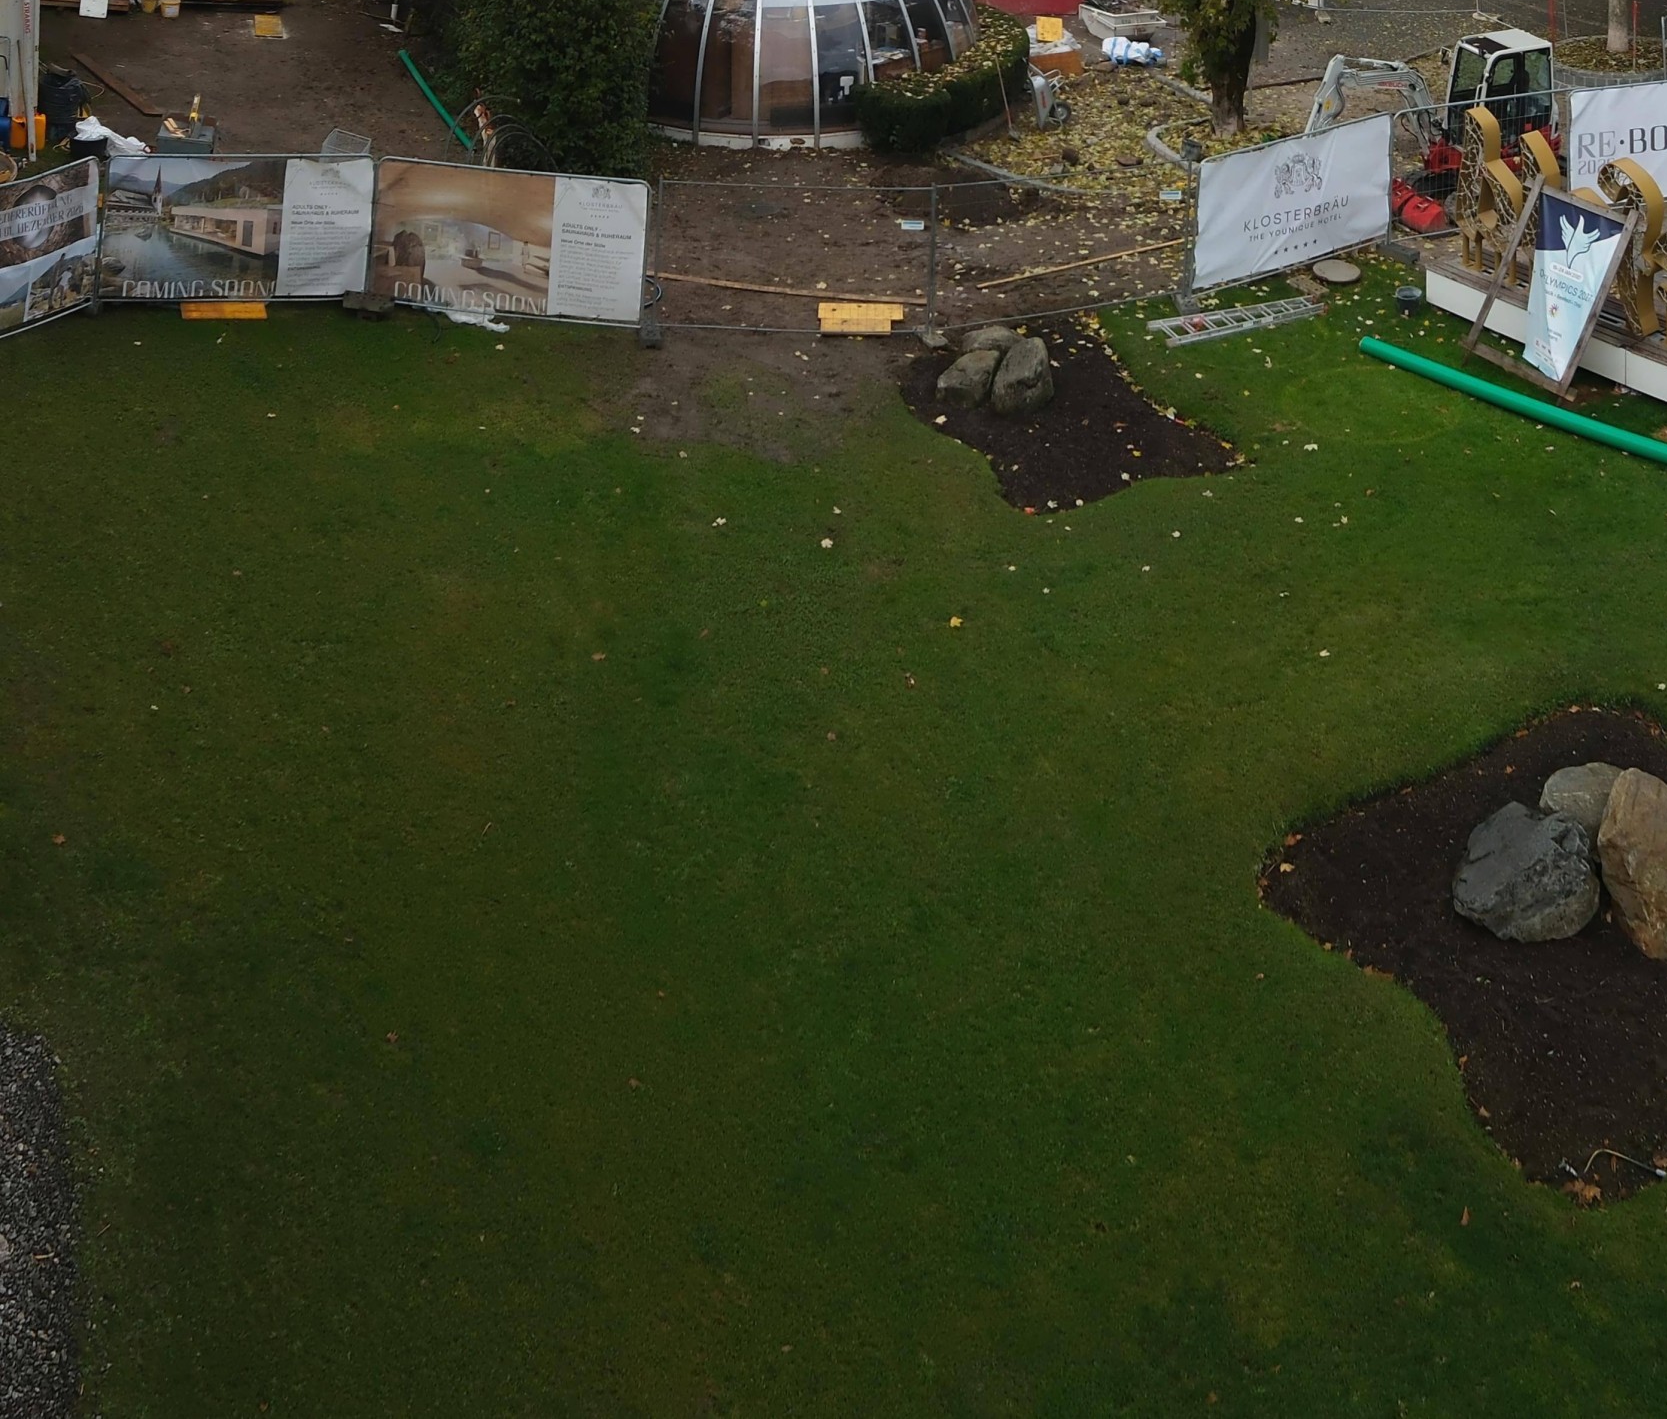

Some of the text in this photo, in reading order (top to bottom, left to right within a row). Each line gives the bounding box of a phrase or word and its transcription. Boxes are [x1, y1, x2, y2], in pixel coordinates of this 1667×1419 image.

[1243, 195, 1349, 232] KLOSTERBRÄU
[1250, 214, 1342, 242] THE YOUNIQUE HOTEL
